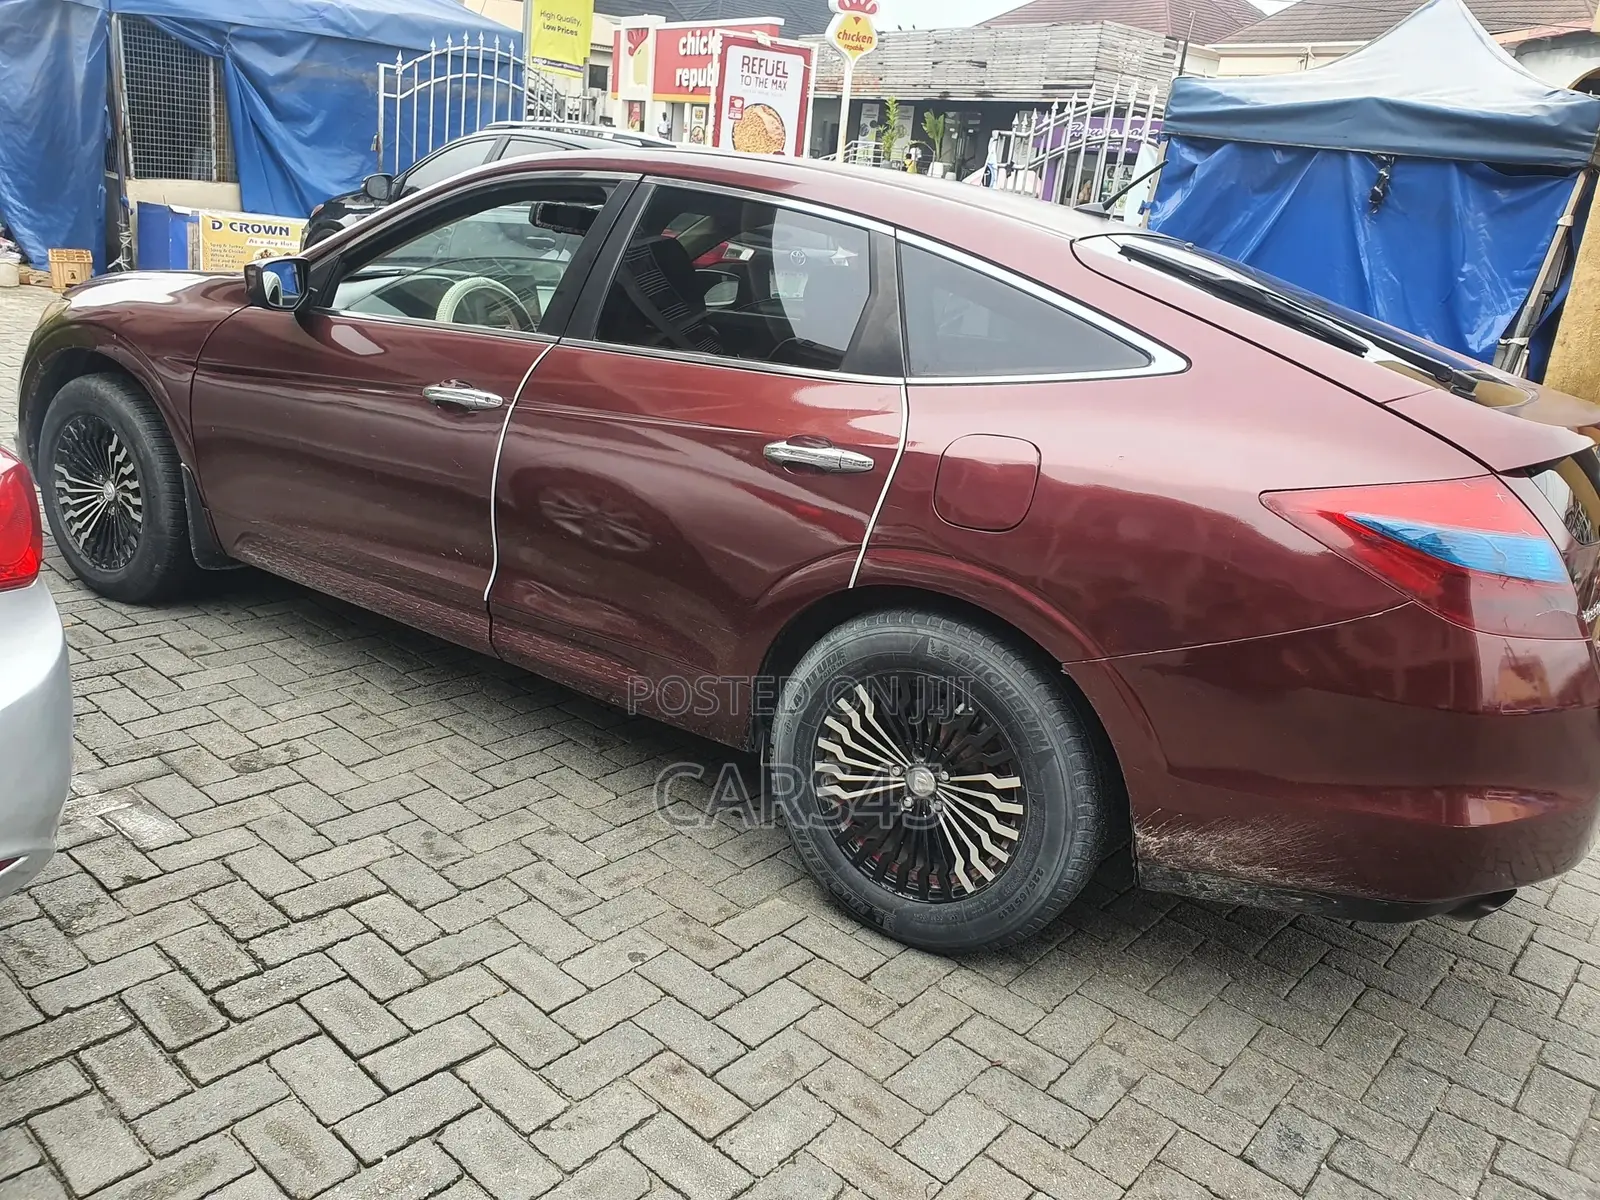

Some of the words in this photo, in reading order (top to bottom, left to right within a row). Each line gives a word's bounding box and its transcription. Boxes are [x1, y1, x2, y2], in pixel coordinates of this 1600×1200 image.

[540, 9, 556, 21] High
[542, 22, 556, 31] Low
[557, 25, 578, 37] Prices
[837, 29, 873, 44] chicken
[740, 55, 789, 79] REFUEL
[740, 74, 752, 86] TO
[755, 76, 769, 89] THE
[771, 79, 788, 92] MAX
[211, 220, 223, 231] D
[229, 221, 290, 237] CROWN
[955, 652, 1051, 750] MICHELIN
